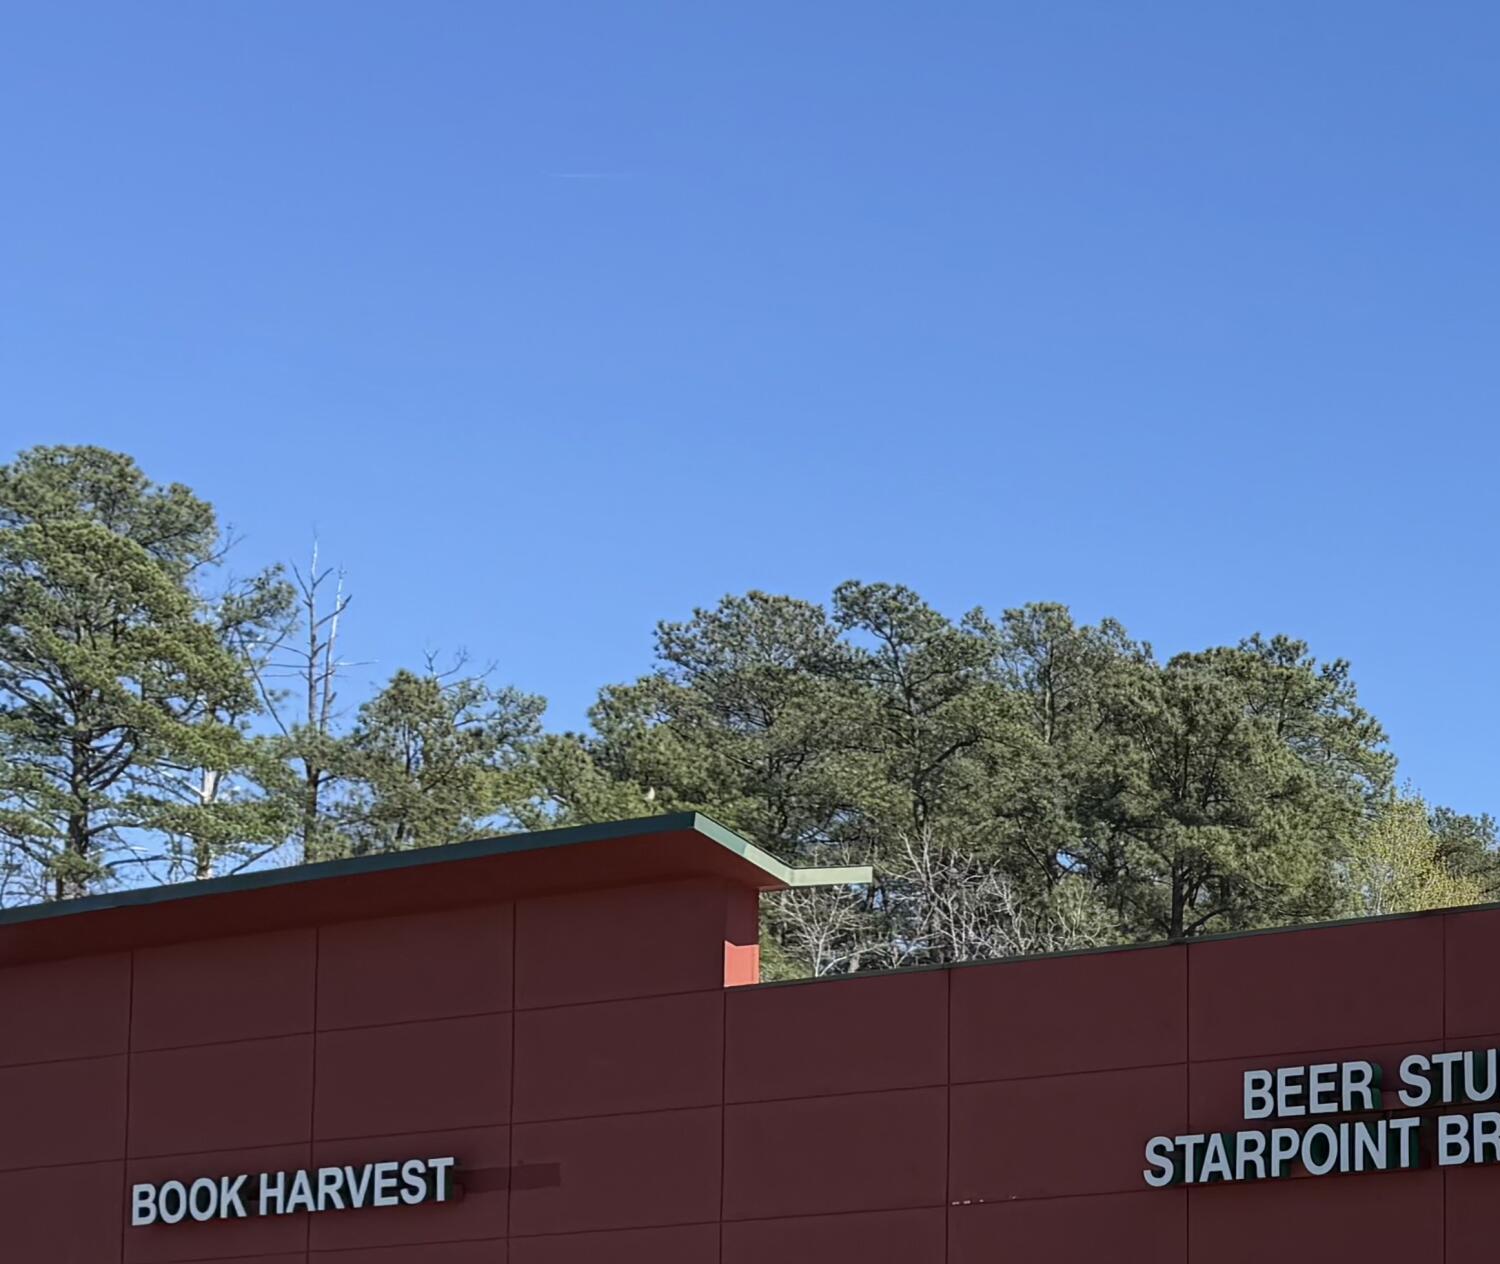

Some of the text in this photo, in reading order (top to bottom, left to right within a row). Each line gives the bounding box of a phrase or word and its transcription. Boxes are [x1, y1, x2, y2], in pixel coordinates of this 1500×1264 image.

[1243, 1061, 1374, 1120] BEER
[1143, 1117, 1421, 1187] STARPOINT
[131, 1157, 454, 1226] BOOK HARVEST
